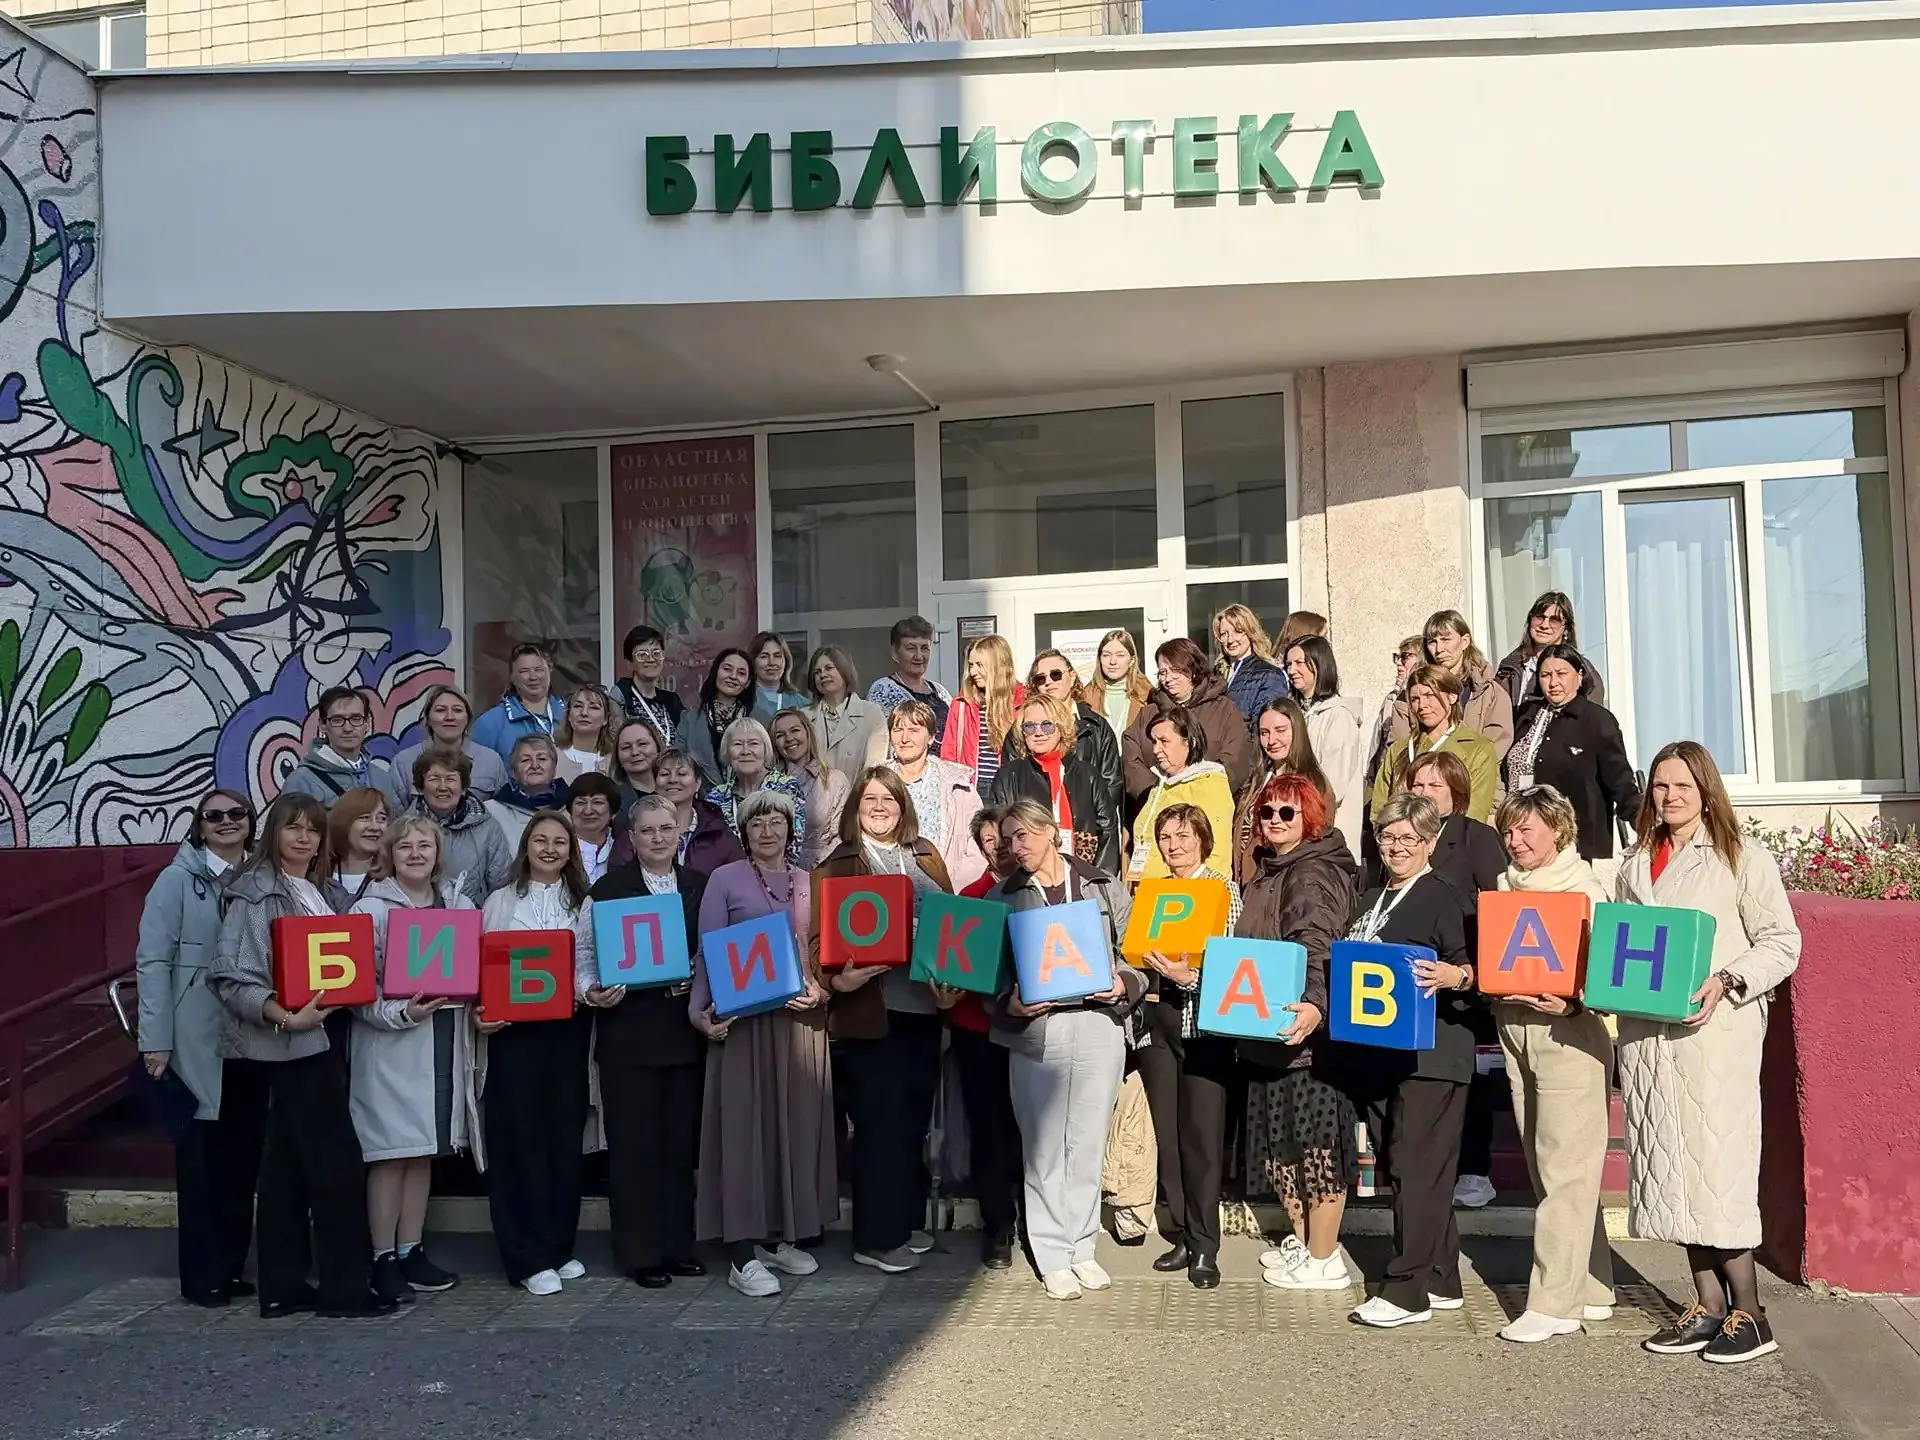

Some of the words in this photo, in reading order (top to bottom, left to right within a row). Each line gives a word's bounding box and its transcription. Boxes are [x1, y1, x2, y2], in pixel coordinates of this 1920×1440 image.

[645, 110, 1385, 216] БИБЛИОТЕКА
[620, 447, 748, 469] ОБЛАСТНАЯ
[623, 471, 749, 492] БИБЛИОТЕКА
